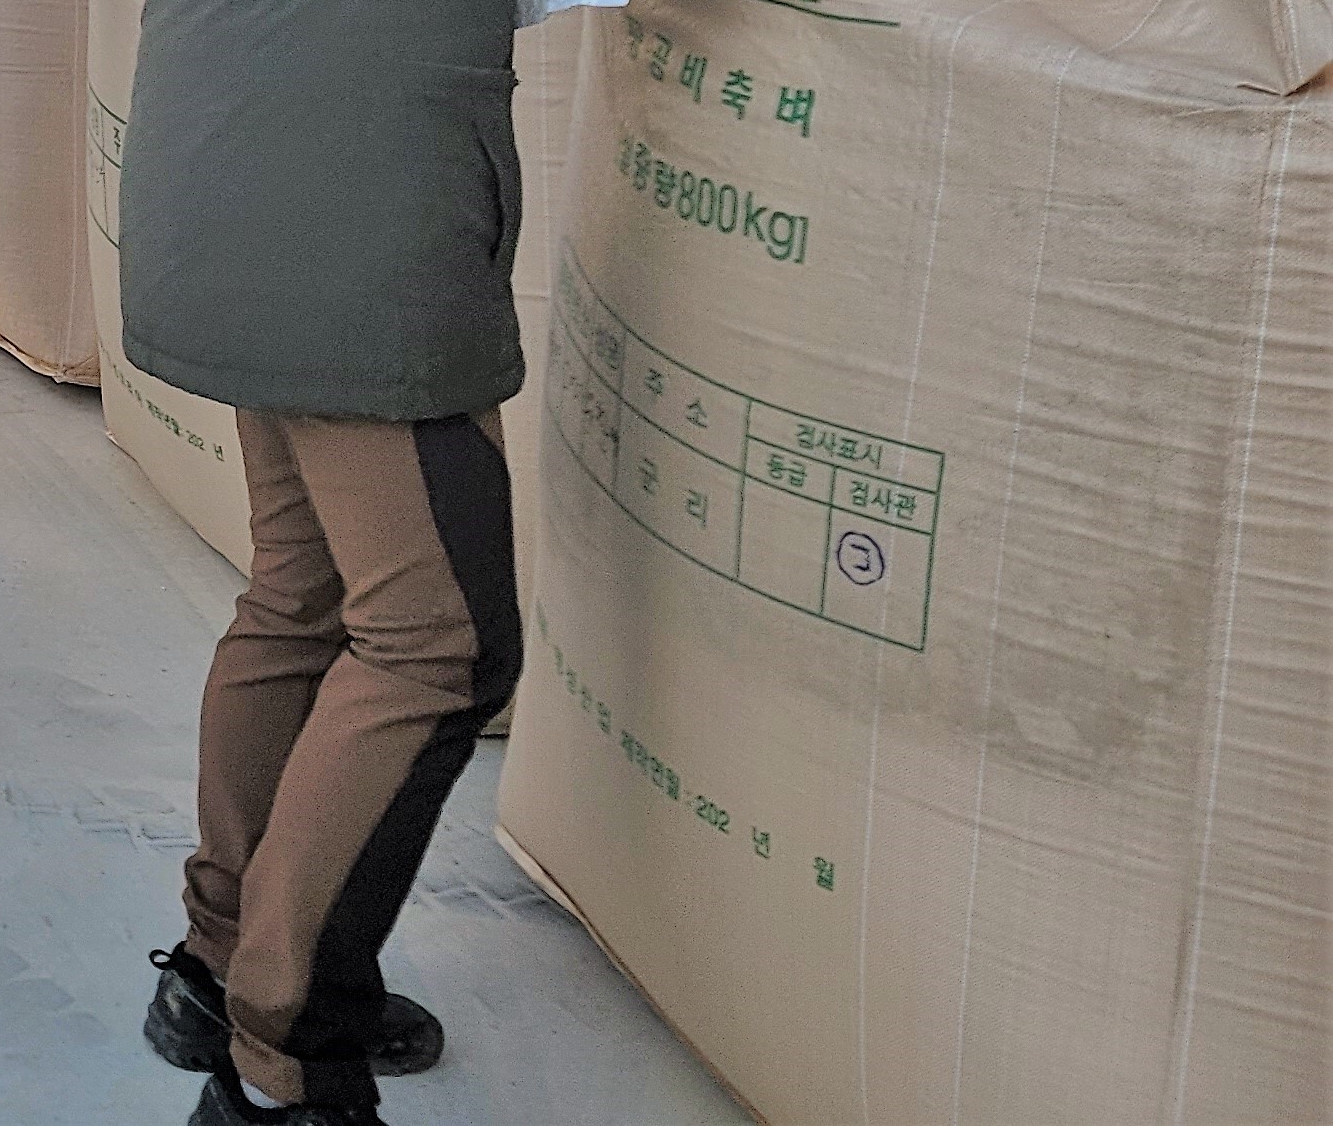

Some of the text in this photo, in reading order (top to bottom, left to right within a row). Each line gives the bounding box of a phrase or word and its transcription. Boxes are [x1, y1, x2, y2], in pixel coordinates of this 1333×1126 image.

[796, 424, 883, 470] 검사표시
[766, 454, 917, 521] 등급 검사관
[751, 826, 771, 860] 년
[814, 856, 835, 892] 월
